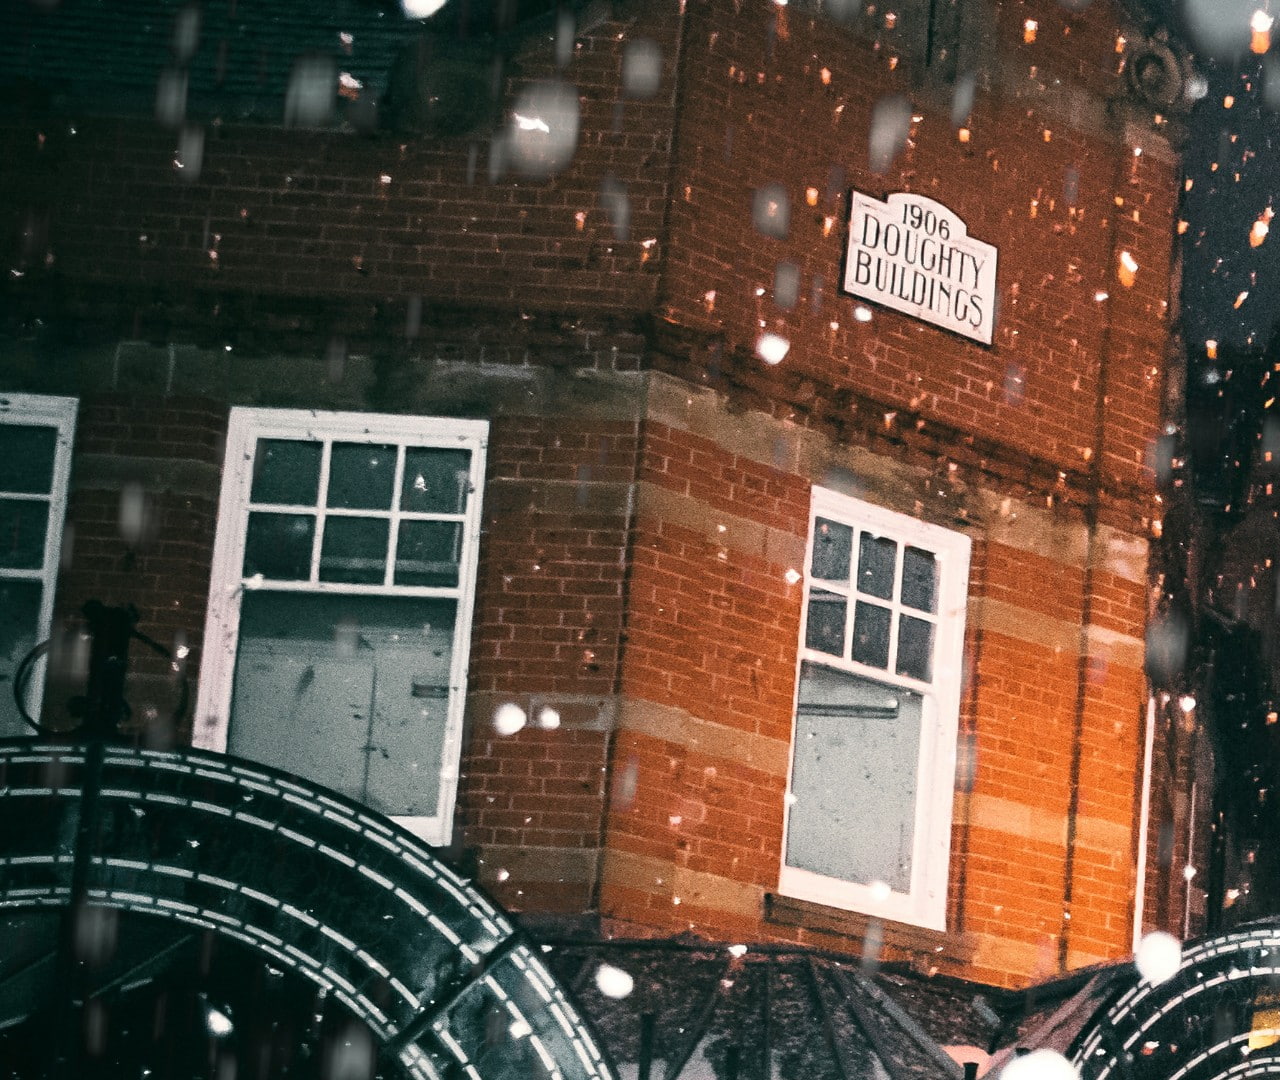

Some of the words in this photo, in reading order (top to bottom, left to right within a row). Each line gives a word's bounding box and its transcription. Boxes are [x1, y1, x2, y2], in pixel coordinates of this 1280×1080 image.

[861, 213, 985, 290] DOUGHTY
[902, 203, 950, 241] 1906
[855, 249, 983, 328] BUILDINGS
